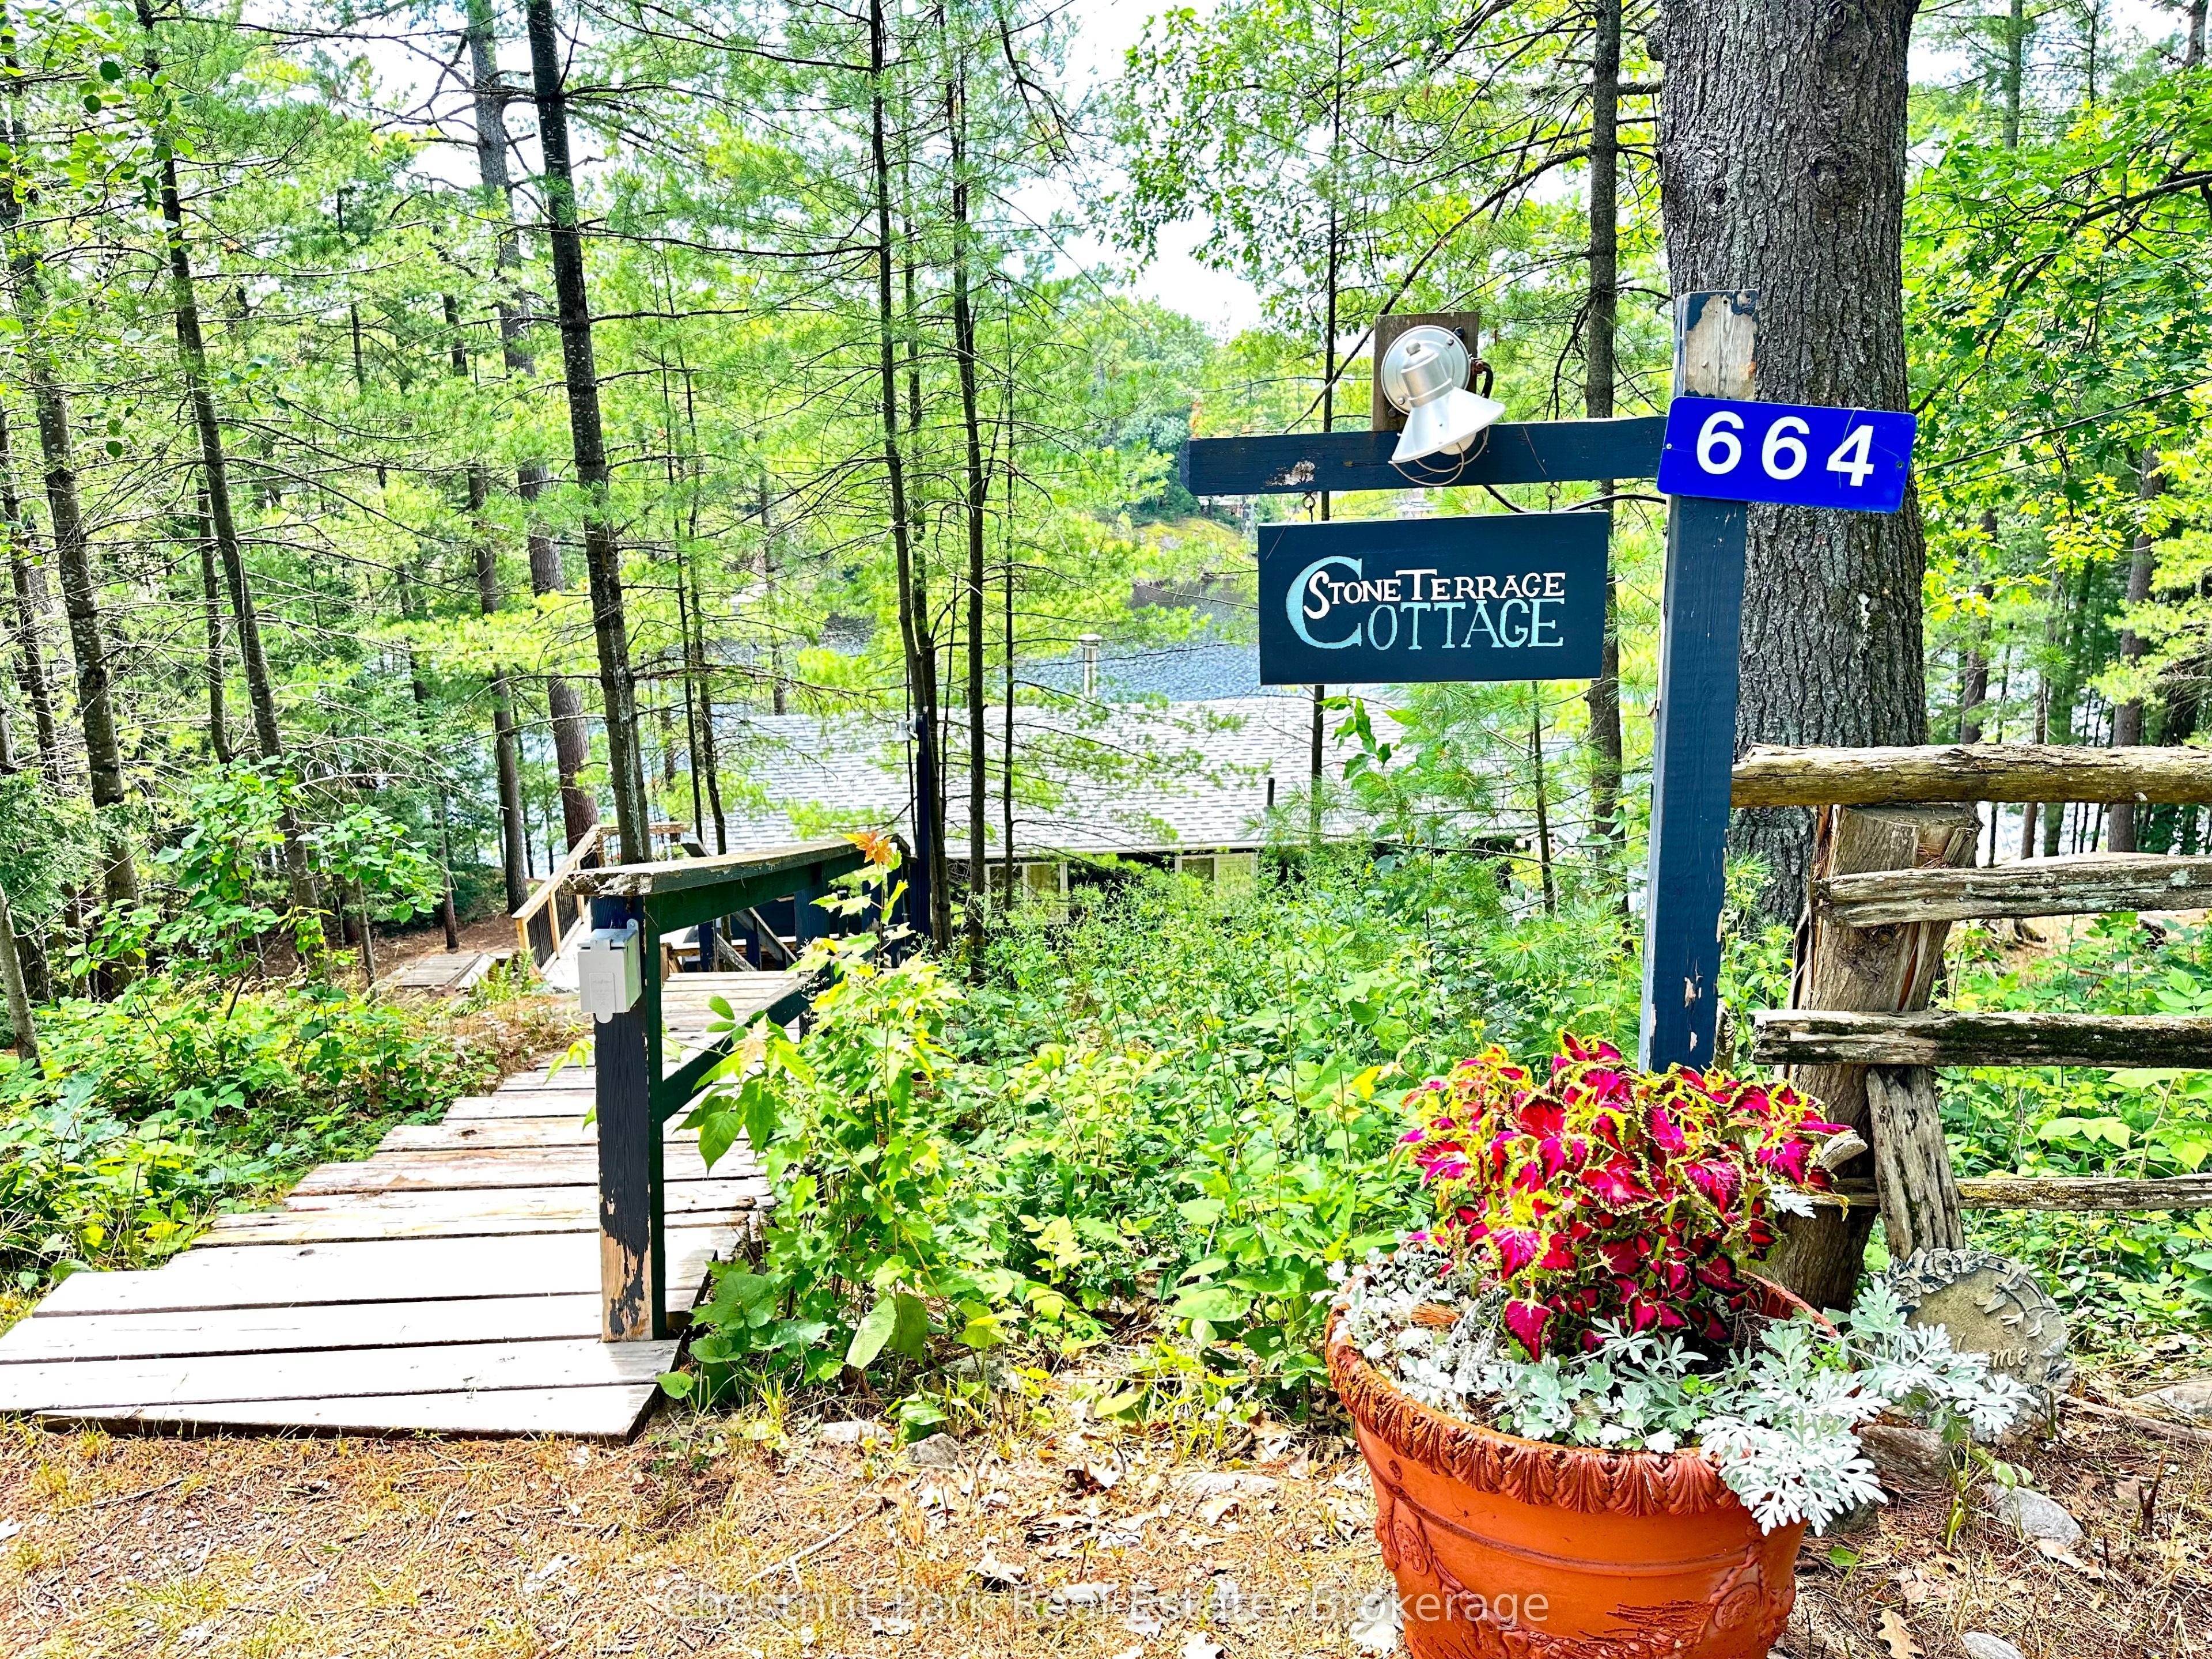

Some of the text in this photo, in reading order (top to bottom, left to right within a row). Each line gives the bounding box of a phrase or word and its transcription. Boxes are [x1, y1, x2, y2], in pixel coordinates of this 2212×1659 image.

[1696, 411, 1874, 487] 664
[1286, 555, 1565, 650] COTTAGE
[1303, 571, 1401, 619] STONE
